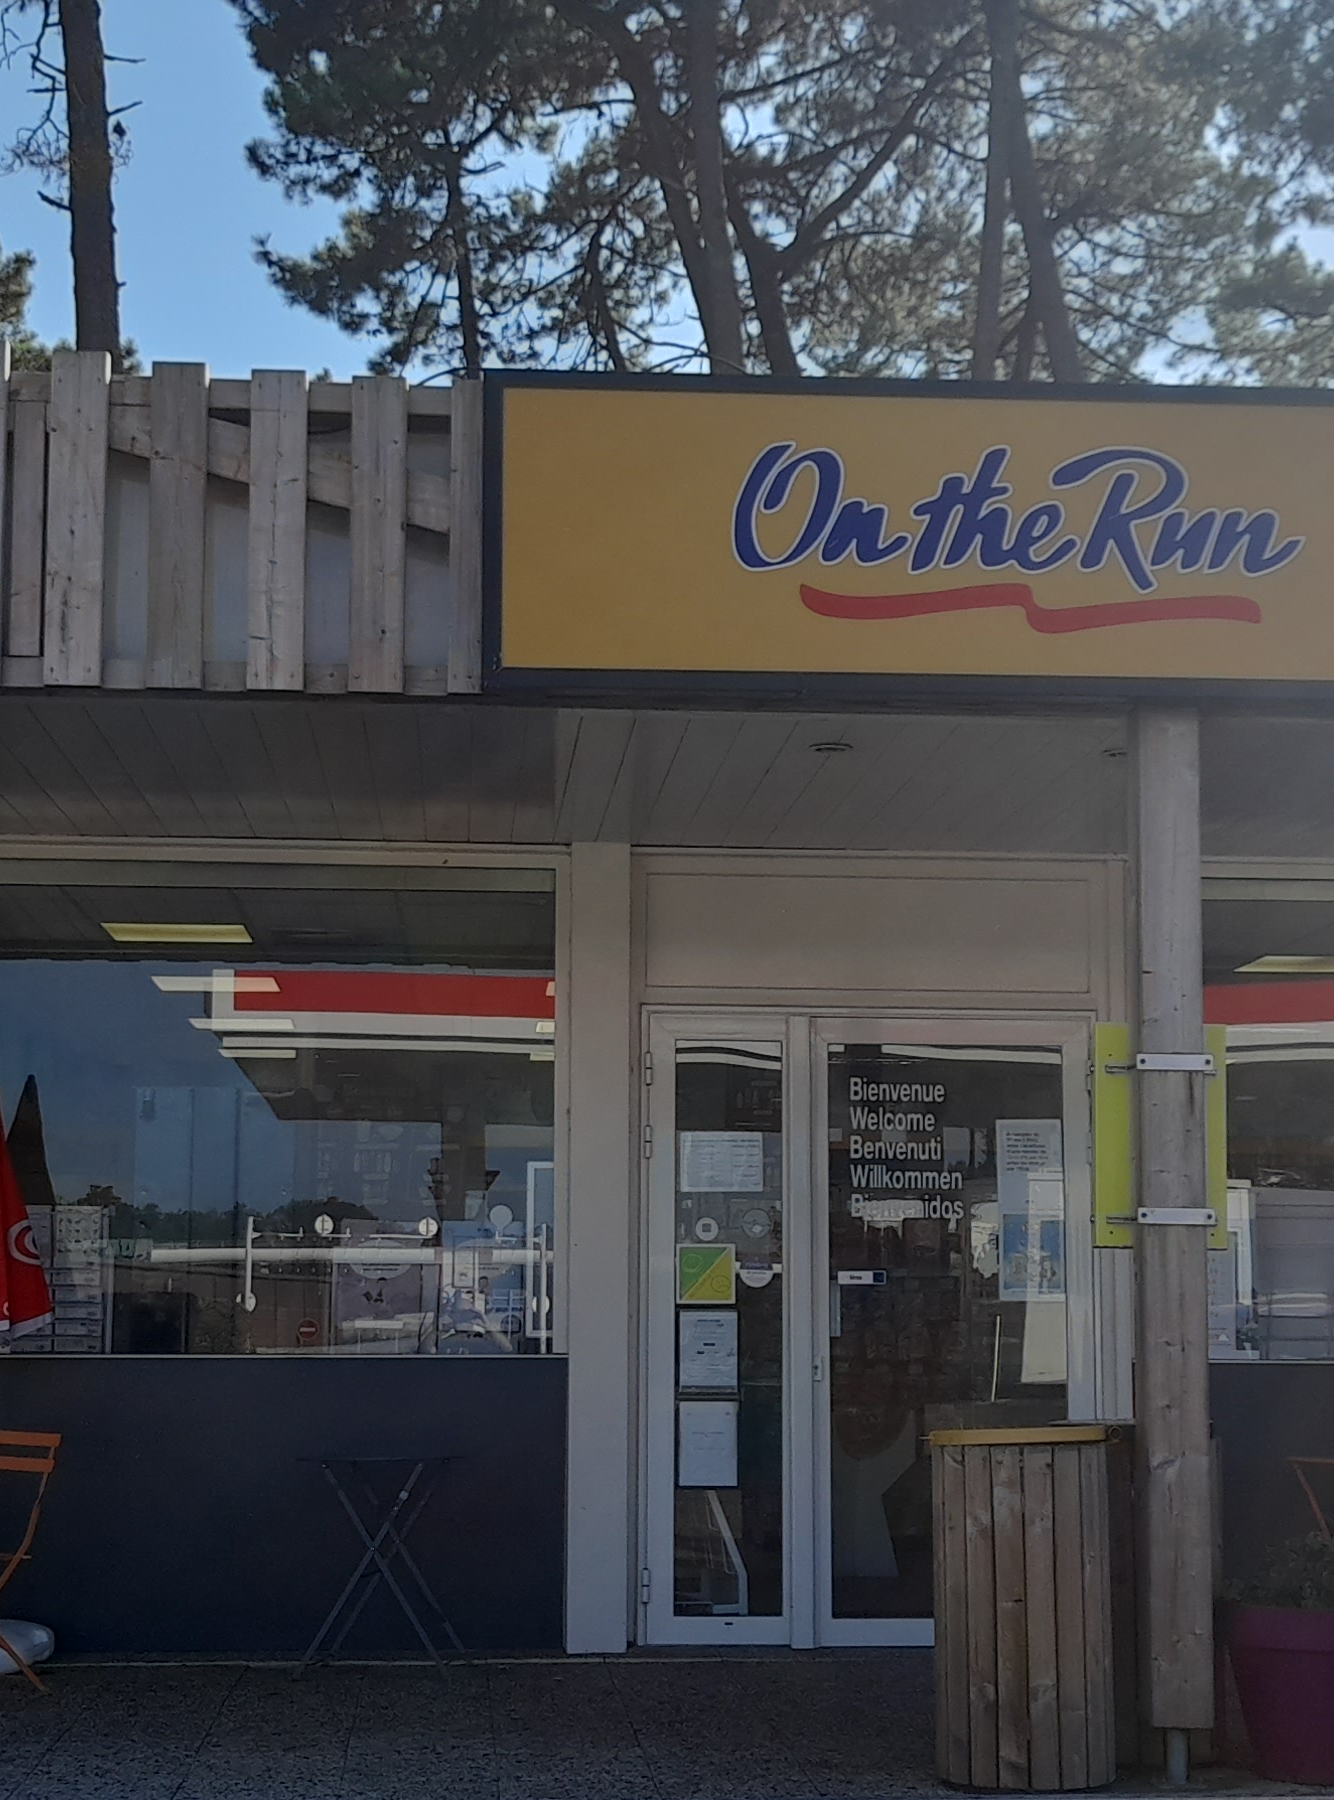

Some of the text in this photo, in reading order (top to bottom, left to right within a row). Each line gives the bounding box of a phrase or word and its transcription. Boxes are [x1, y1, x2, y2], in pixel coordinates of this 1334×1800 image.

[733, 438, 1306, 594] On the Run
[849, 1076, 945, 1102] Bienvenue
[849, 1106, 936, 1132] Welcome
[849, 1135, 942, 1161] Benvenuti
[849, 1164, 963, 1190] Willkommen
[850, 1193, 965, 1220] Bieidos
